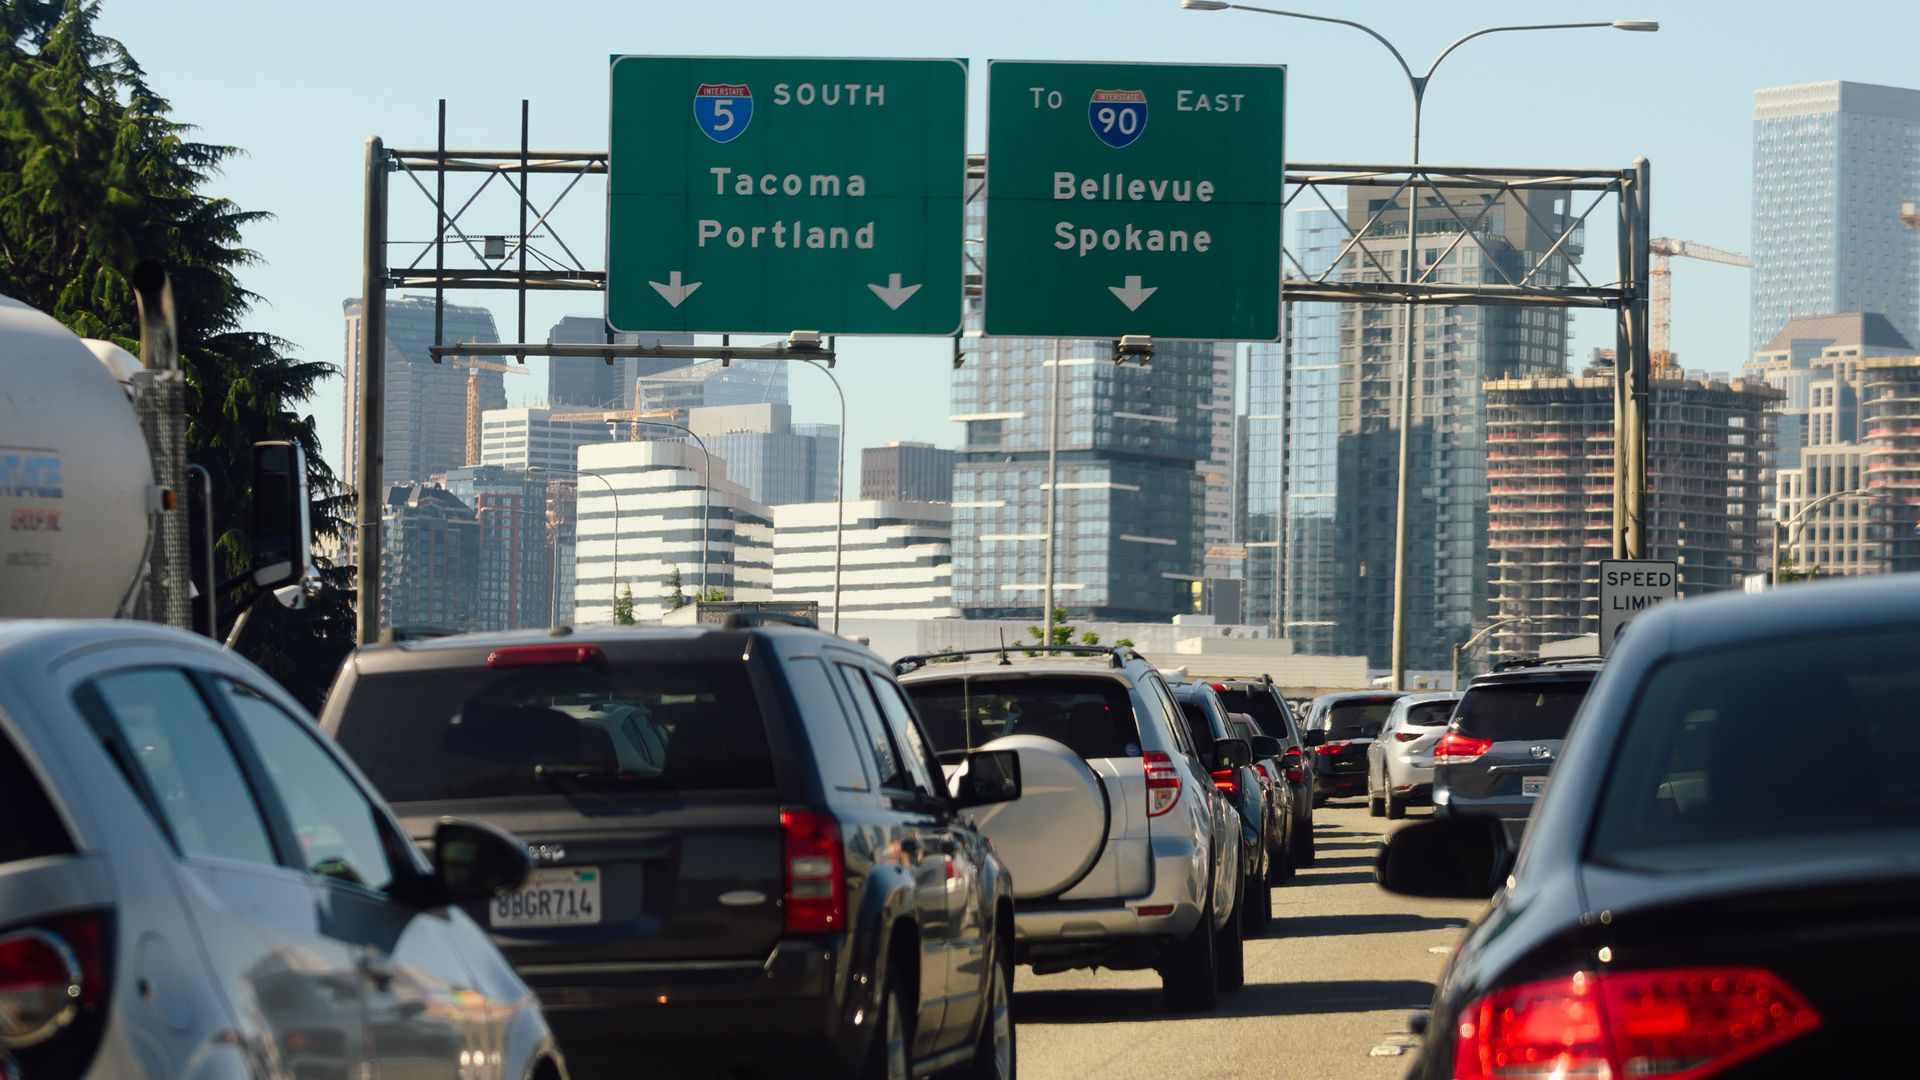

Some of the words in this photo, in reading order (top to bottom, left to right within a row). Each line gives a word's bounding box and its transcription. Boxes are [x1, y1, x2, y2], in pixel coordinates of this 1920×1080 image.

[703, 87, 746, 96] INTERSTATE
[773, 83, 885, 106] SOUTH
[1177, 90, 1245, 112] EAST
[713, 100, 734, 131] 5
[1098, 108, 1136, 134] 90
[711, 168, 864, 196] Tacoma
[1054, 172, 1214, 201] Bellevue
[699, 220, 873, 248] Portland
[1055, 222, 1210, 256] Spokane
[1607, 572, 1671, 586] SPEED
[497, 889, 593, 917] 8BGR714
